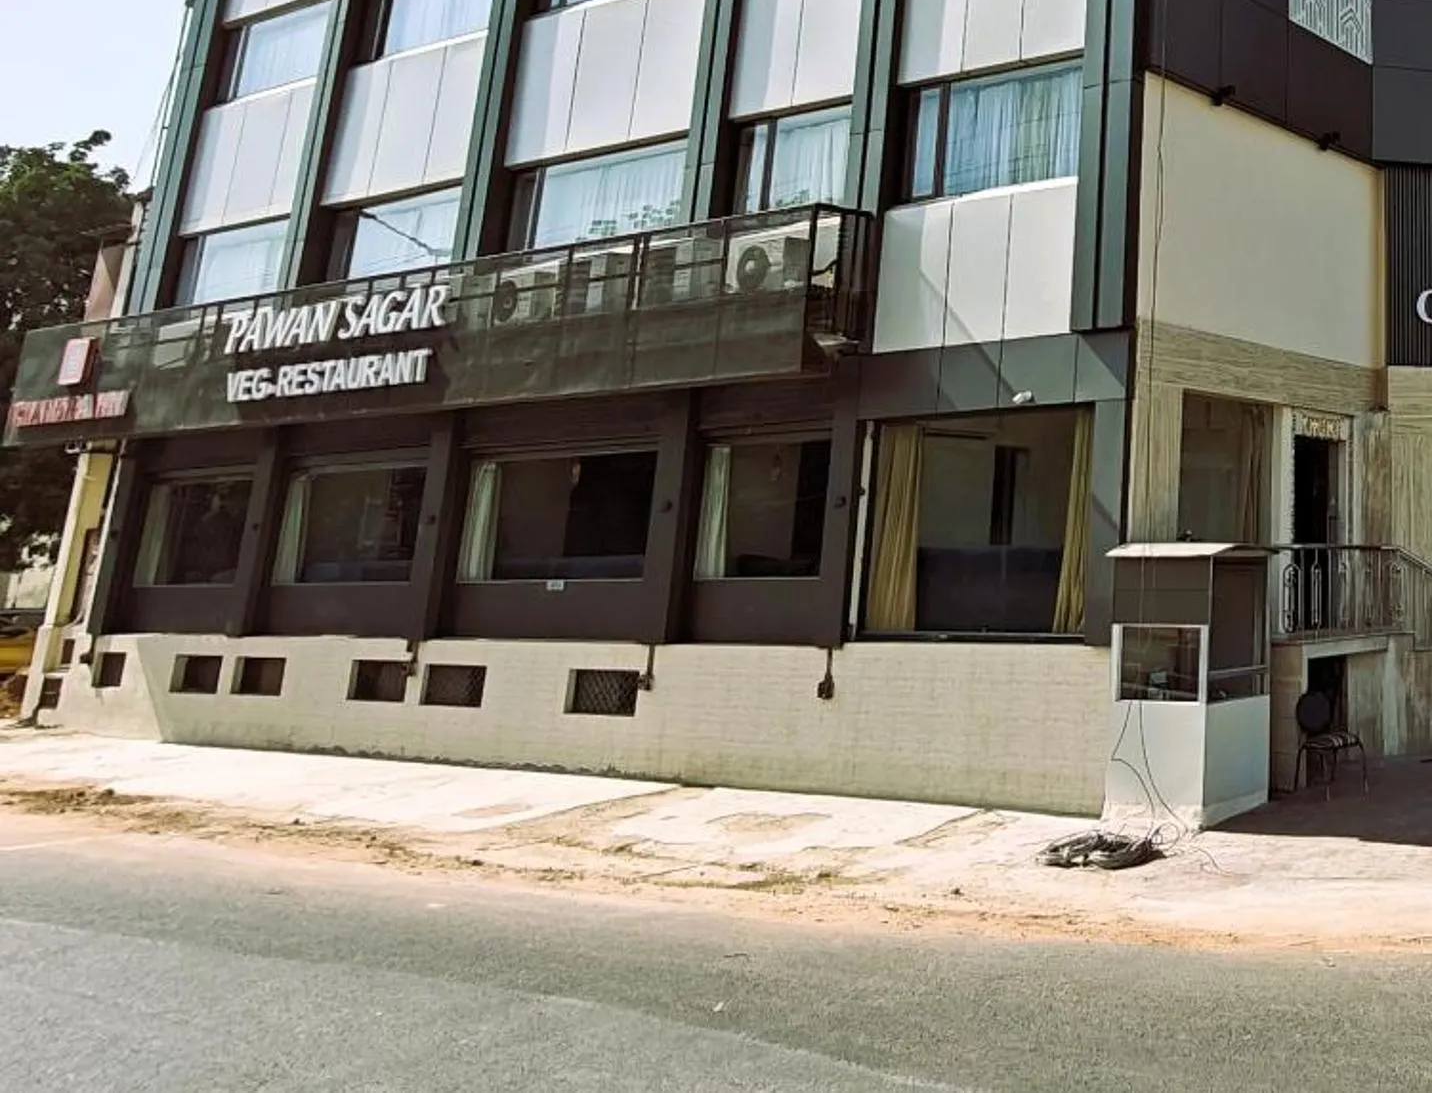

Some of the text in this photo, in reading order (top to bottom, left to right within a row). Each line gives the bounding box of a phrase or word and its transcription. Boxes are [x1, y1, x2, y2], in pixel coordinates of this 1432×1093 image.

[222, 283, 449, 354] PAWAN SAGAR
[227, 348, 433, 402] VEG-RESTAURANT
